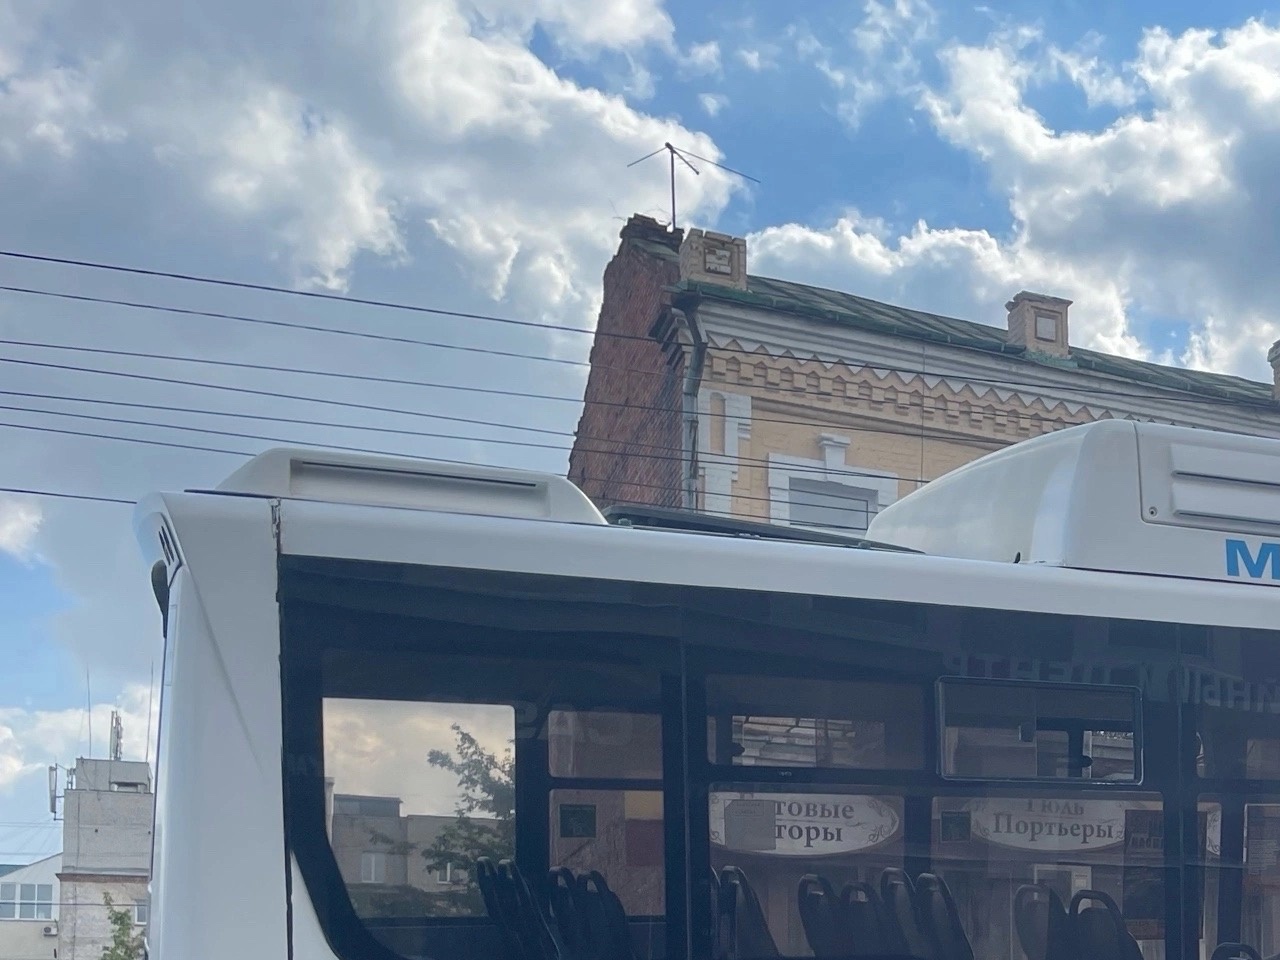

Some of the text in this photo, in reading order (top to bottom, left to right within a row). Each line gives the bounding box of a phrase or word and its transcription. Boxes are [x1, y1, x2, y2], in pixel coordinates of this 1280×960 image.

[775, 801, 854, 820] товые
[775, 823, 843, 848] торы
[993, 813, 1114, 844] Портьеры
